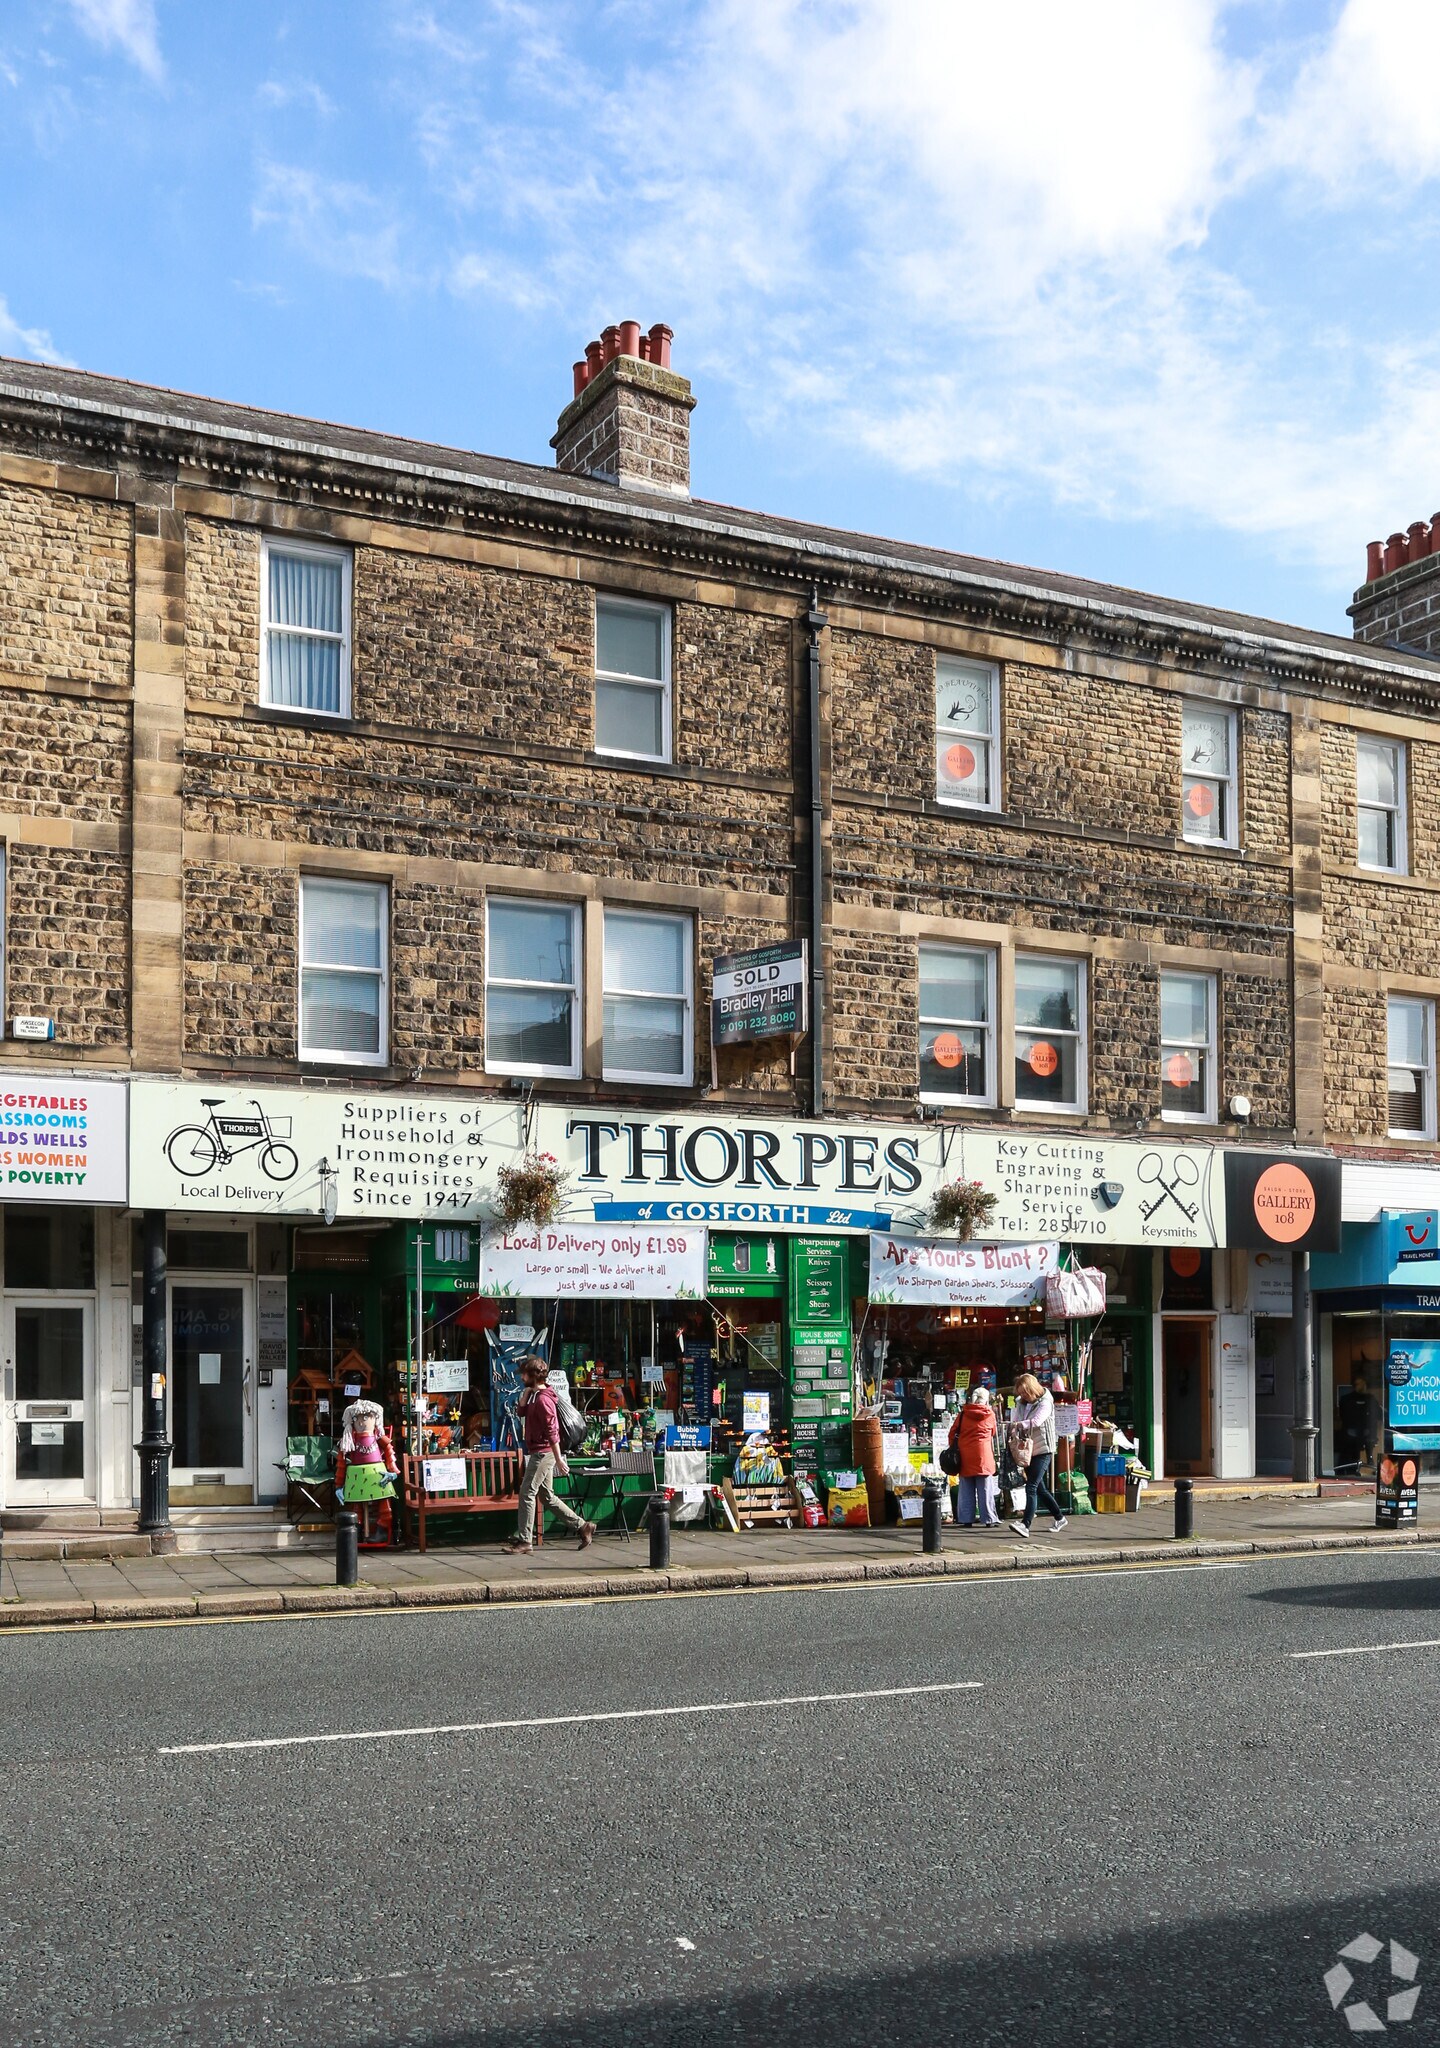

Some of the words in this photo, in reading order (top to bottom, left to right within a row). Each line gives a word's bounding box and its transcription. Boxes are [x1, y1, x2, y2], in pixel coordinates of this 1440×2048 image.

[733, 965, 780, 988] SOLD
[720, 992, 766, 1013] Bradley
[770, 984, 795, 1004] Hall
[728, 1020, 747, 1032] 0191
[750, 1016, 767, 1028] 232
[770, 1011, 796, 1025] 8080
[344, 1102, 448, 1123] Suppliers
[460, 1110, 482, 1125] of
[223, 1124, 259, 1134] THORPES
[341, 1123, 454, 1144] Household
[467, 1133, 484, 1146] &
[33, 1133, 88, 1148] WELLS
[336, 1144, 488, 1170] Ironmongery
[566, 1118, 922, 1196] THORPES
[997, 1140, 1028, 1158] Key
[1037, 1143, 1104, 1162] Cutting
[17, 1152, 87, 1167] WOMEN
[353, 1166, 474, 1187] Requisites
[996, 1160, 1082, 1180] Engraving
[1092, 1167, 1105, 1179] &
[8, 1170, 87, 1186] POVERTY
[180, 1183, 219, 1198] Local
[225, 1185, 284, 1202] Delivery
[1004, 1179, 1099, 1200] Sharpening
[353, 1188, 412, 1205] Since
[425, 1191, 473, 1208] 1947
[1257, 1194, 1312, 1210] GALLERY
[637, 1207, 652, 1219] of
[666, 1203, 810, 1223] GOSFORTH
[825, 1210, 850, 1225] Ltd
[1022, 1198, 1083, 1215] Service
[999, 1216, 1029, 1231] Tel:
[1275, 1212, 1294, 1224] 108
[1141, 1225, 1198, 1238] Keysmiths
[502, 1233, 541, 1252] Local
[547, 1234, 605, 1257] Delivery
[646, 1237, 687, 1255] £1.99
[798, 1238, 841, 1248] Sharpening
[806, 1247, 832, 1255] Services
[886, 1241, 919, 1266] Are
[924, 1244, 976, 1268] Yours
[981, 1245, 1032, 1270] Blunt
[526, 1263, 551, 1275] Large
[554, 1265, 564, 1274] or
[567, 1263, 589, 1274] small
[599, 1264, 612, 1275] We
[616, 1264, 645, 1275] deliver
[647, 1263, 654, 1274] it
[656, 1264, 666, 1275] all
[710, 1265, 724, 1273] etc.
[808, 1258, 831, 1266] Knives
[557, 1281, 576, 1291] Just
[578, 1280, 597, 1291] give
[600, 1281, 610, 1290] us
[612, 1282, 618, 1290] a
[620, 1281, 634, 1291] call
[707, 1284, 745, 1294] Measure
[897, 1276, 909, 1286] We
[911, 1277, 942, 1289] Sharpen
[944, 1278, 970, 1288] Garden
[972, 1279, 998, 1289] Shears,
[949, 1292, 973, 1302] Knives
[975, 1293, 987, 1302] etc
[833, 1366, 843, 1375] 26
[795, 1384, 808, 1392] ONE
[1396, 1390, 1405, 1402] IS
[1396, 1404, 1409, 1416] TO
[1411, 1404, 1426, 1416] TUI
[677, 1425, 699, 1433] Bubble
[1380, 1487, 1396, 1495] AVEDA
[1400, 1488, 1416, 1496] AVEDA
